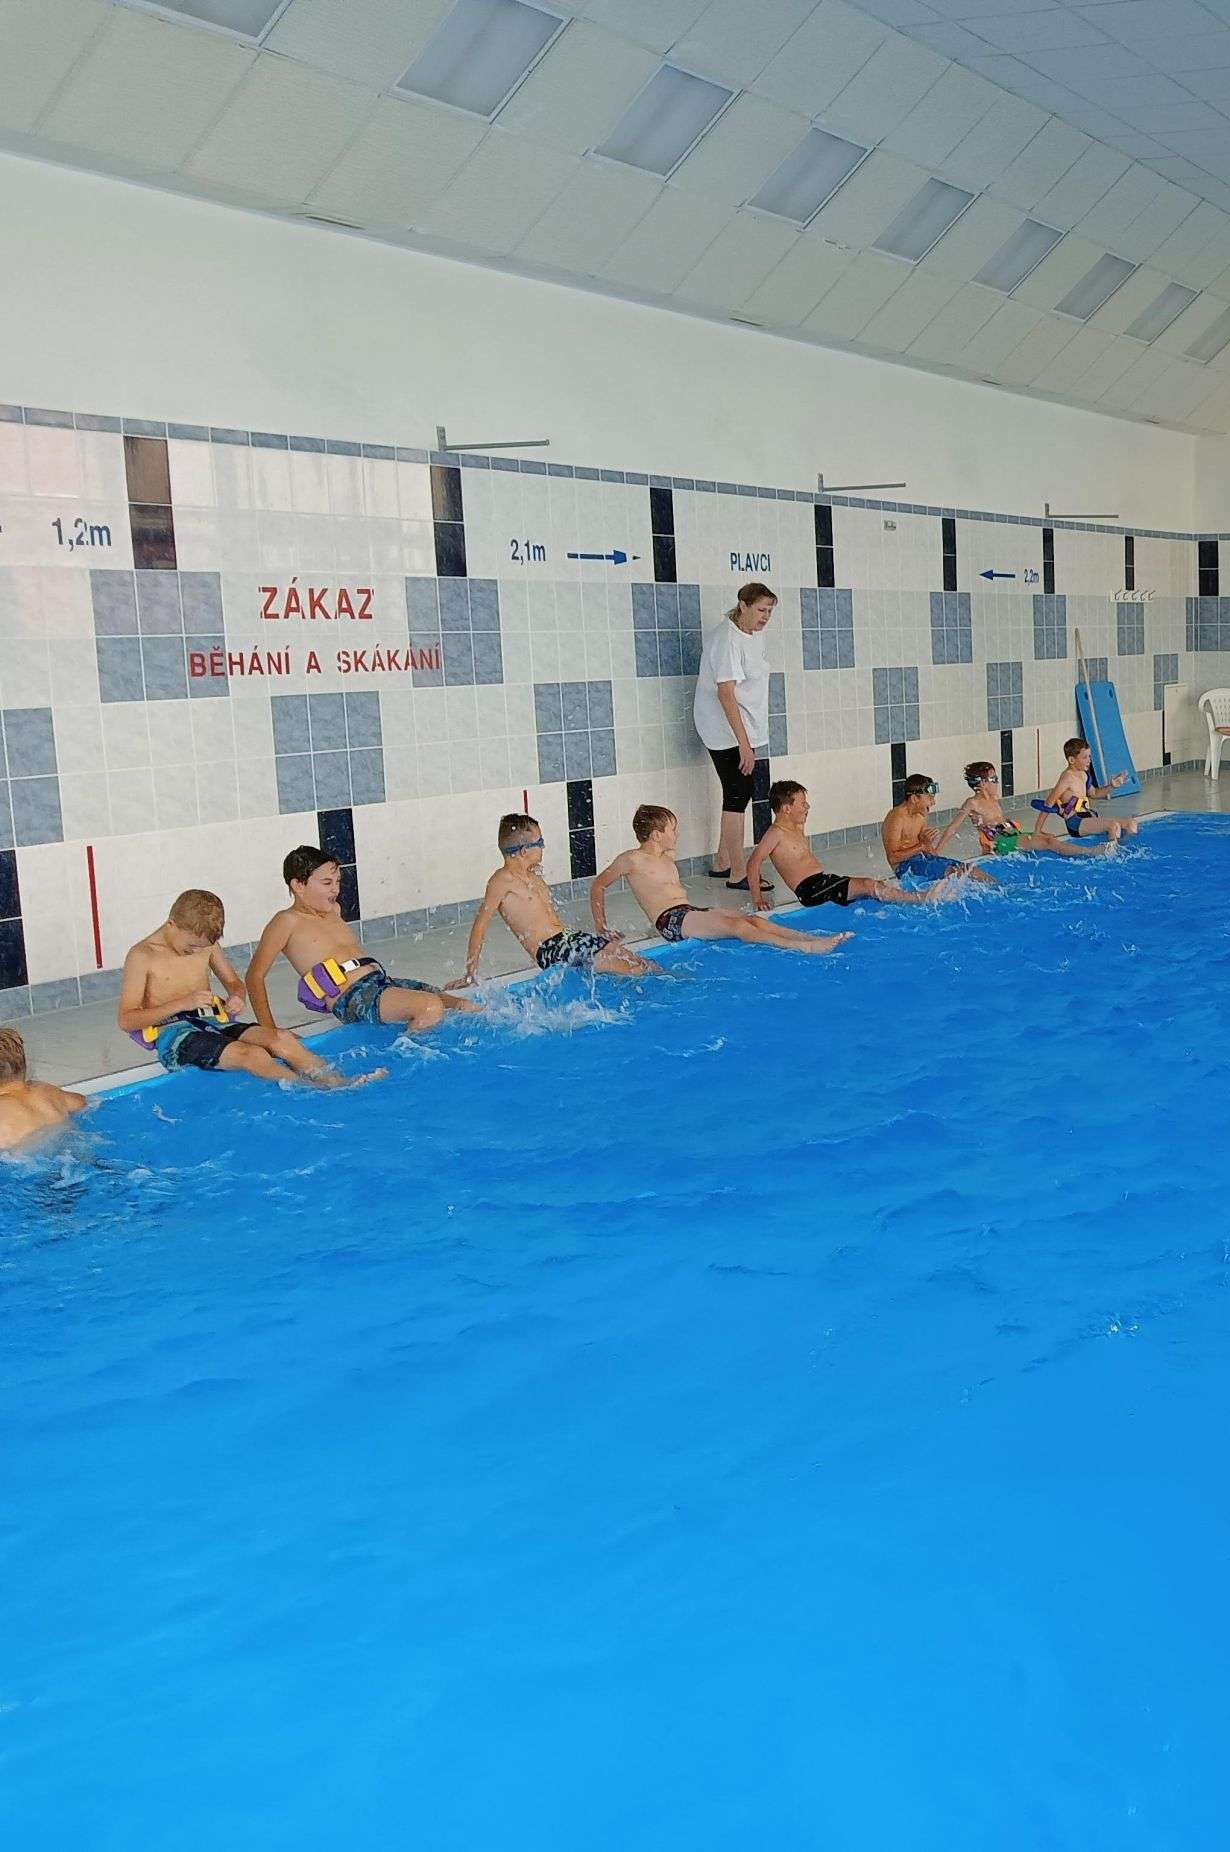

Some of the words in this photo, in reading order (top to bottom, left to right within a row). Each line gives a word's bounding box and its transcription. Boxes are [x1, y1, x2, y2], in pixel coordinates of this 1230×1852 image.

[51, 517, 112, 552] 1,2m
[510, 539, 546, 565] 2,1m
[730, 552, 771, 572] PLAVCI
[258, 577, 374, 620] ZÁKAZ
[189, 645, 291, 677] BĚHÁNÍ
[306, 650, 321, 674] A
[336, 642, 442, 674] SKÁKÁNÍ
